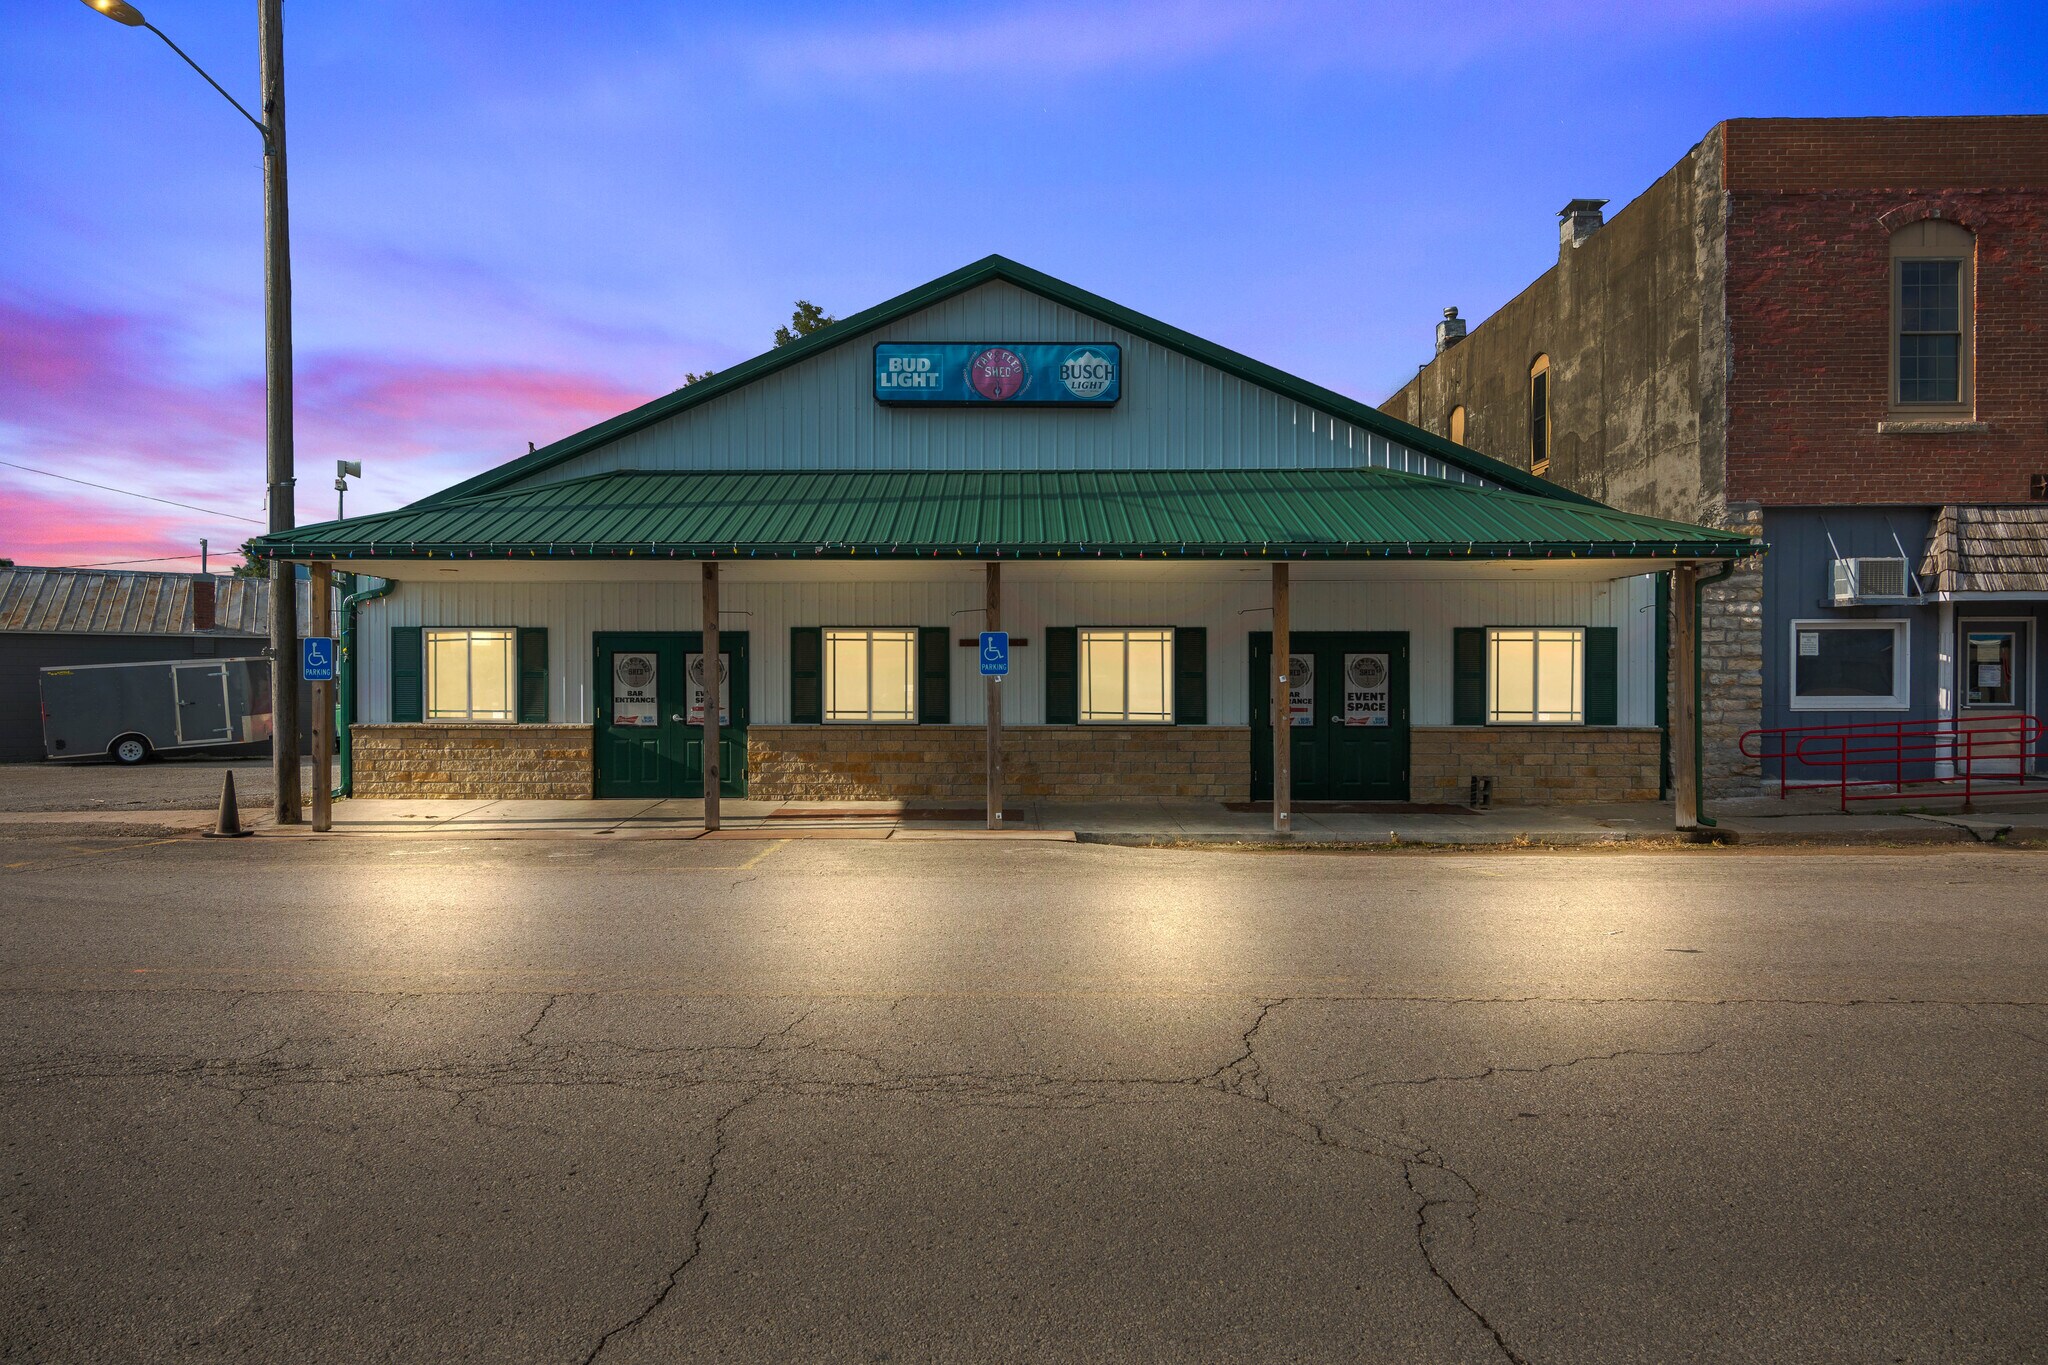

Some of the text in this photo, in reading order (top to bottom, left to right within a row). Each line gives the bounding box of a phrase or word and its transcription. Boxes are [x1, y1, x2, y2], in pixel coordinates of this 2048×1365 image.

[889, 357, 932, 373] BUD
[974, 351, 993, 369] TAP
[1002, 352, 1022, 374] FEED
[984, 366, 1011, 378] SHED
[1059, 364, 1115, 381] BUSCH
[880, 372, 940, 388] LIGHT
[1071, 381, 1104, 390] LIGHT
[1347, 692, 1386, 701] EVENT
[1347, 702, 1386, 711] SPACE
